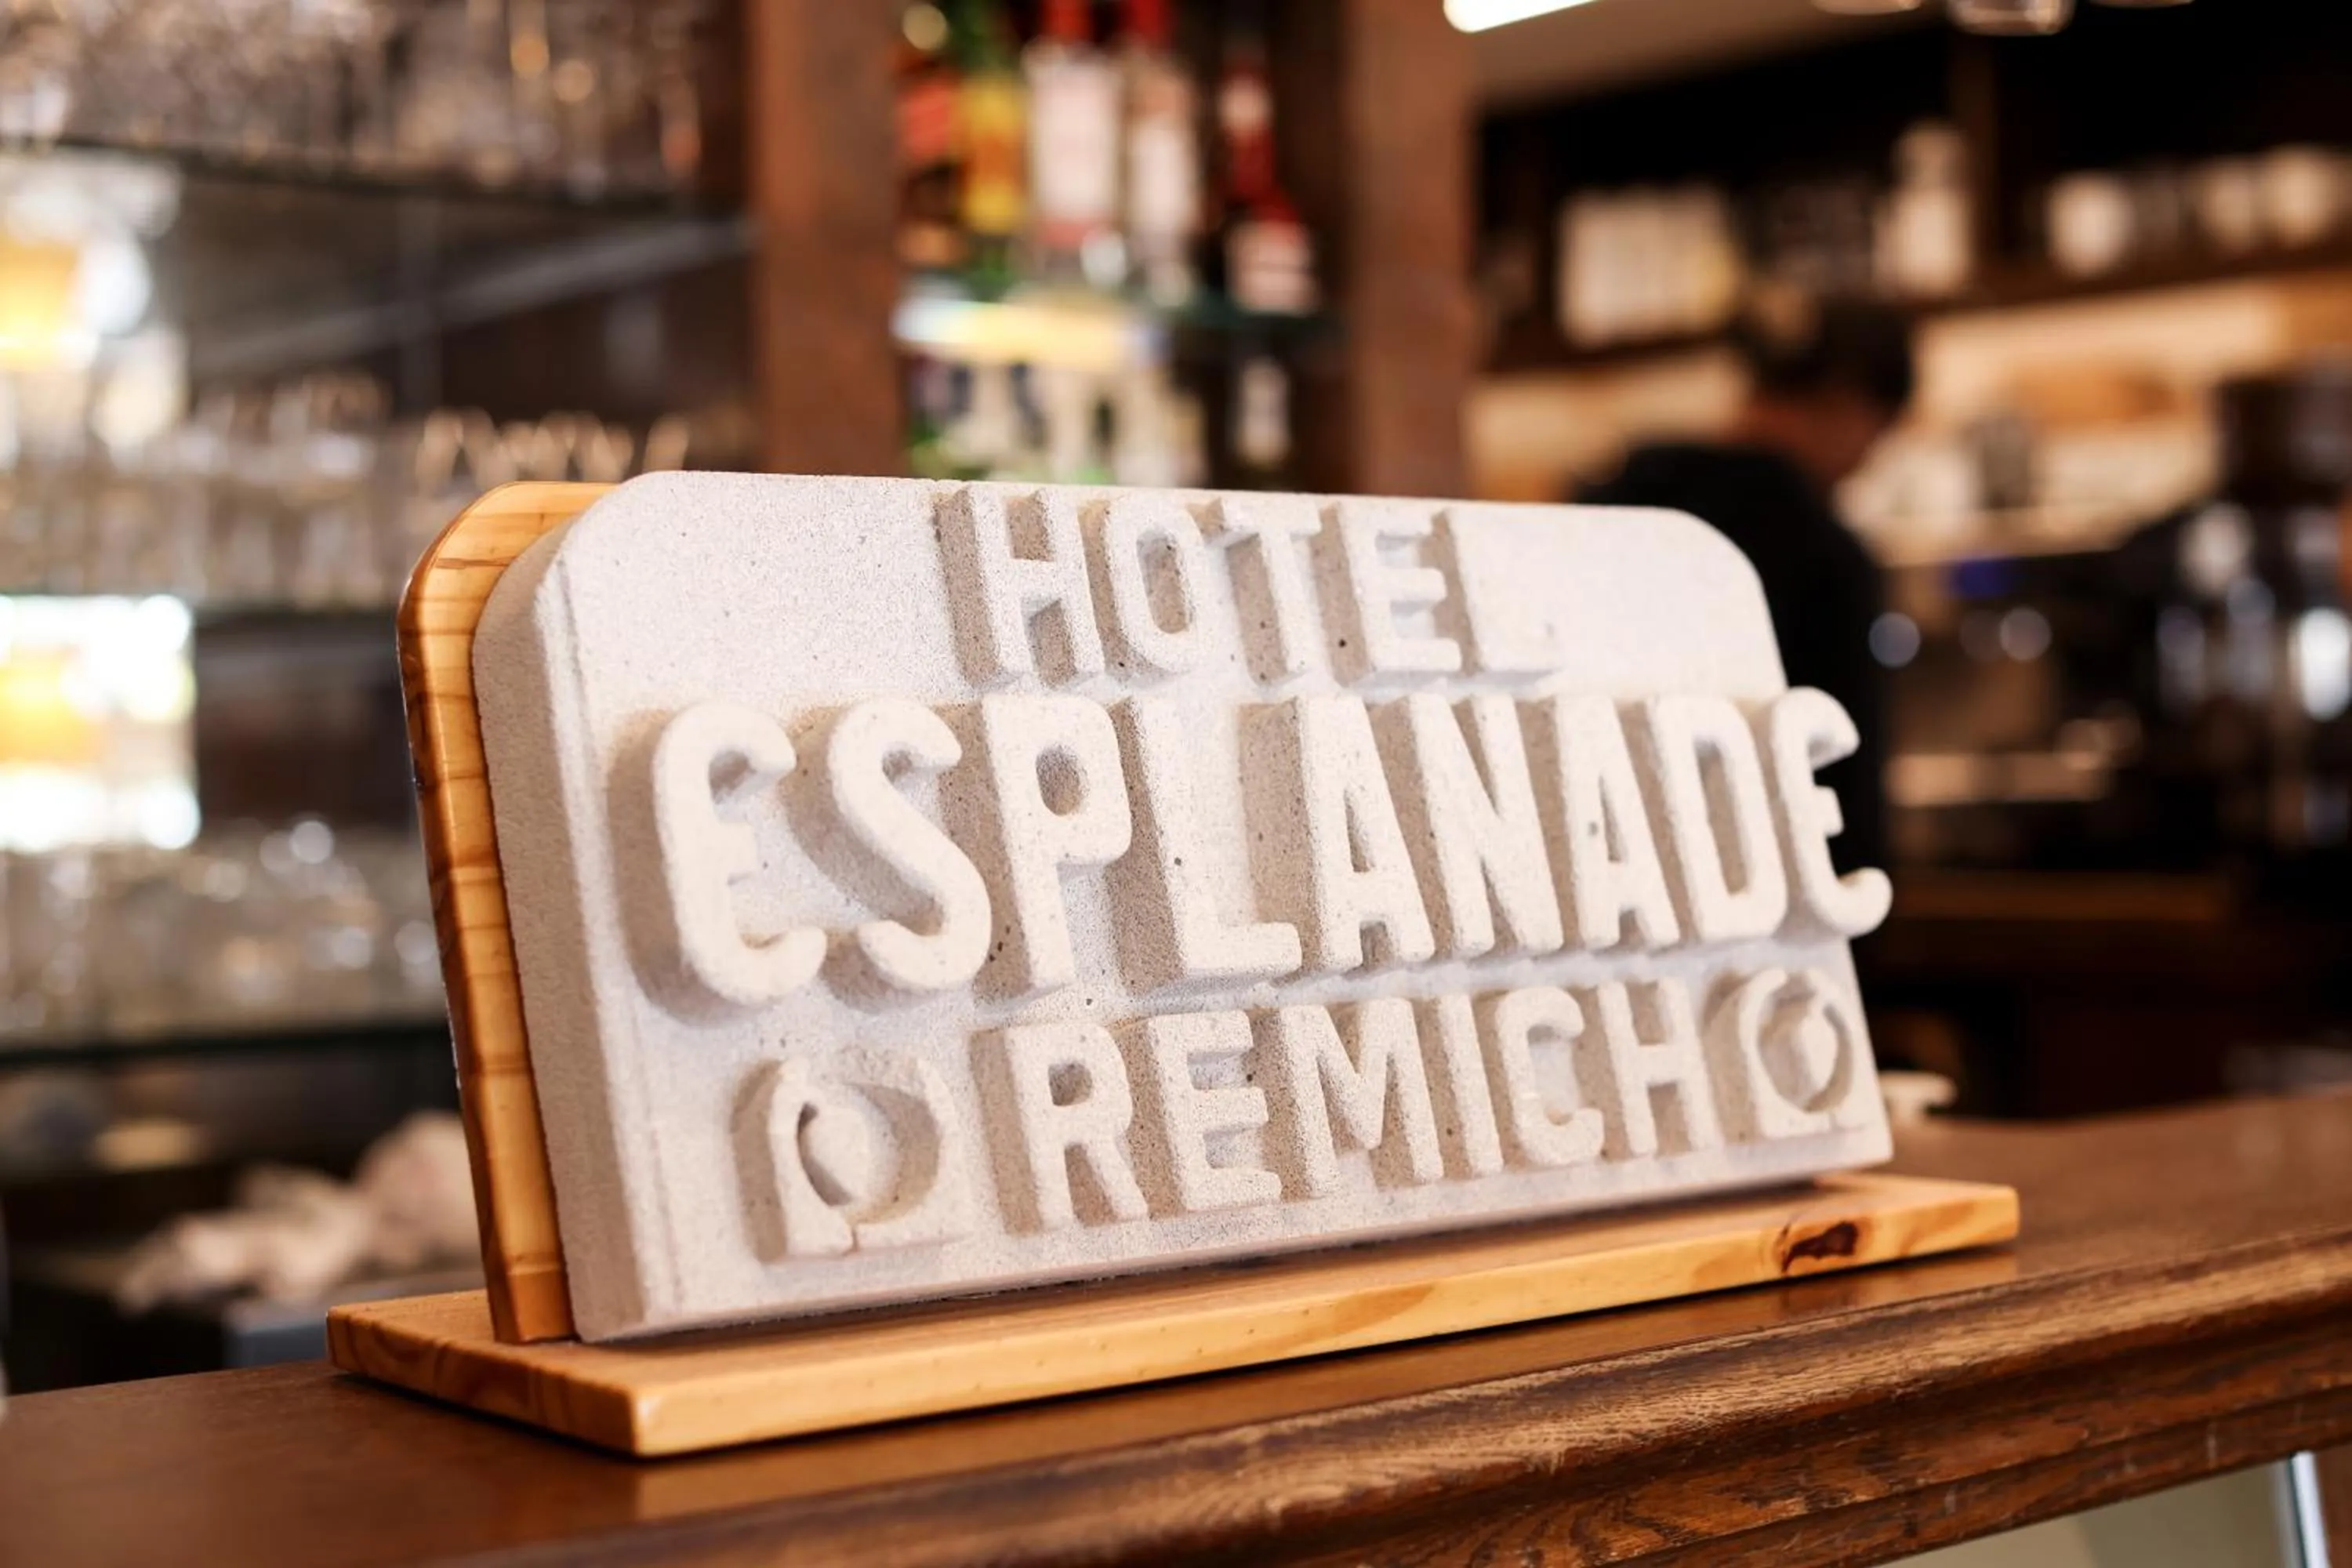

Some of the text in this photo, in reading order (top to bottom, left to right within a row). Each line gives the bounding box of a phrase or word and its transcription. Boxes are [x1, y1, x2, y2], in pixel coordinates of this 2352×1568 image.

[964, 485, 1560, 684] HOTEL
[652, 684, 1894, 1004] ESPLANADE
[1005, 977, 1721, 1225] REMICH
